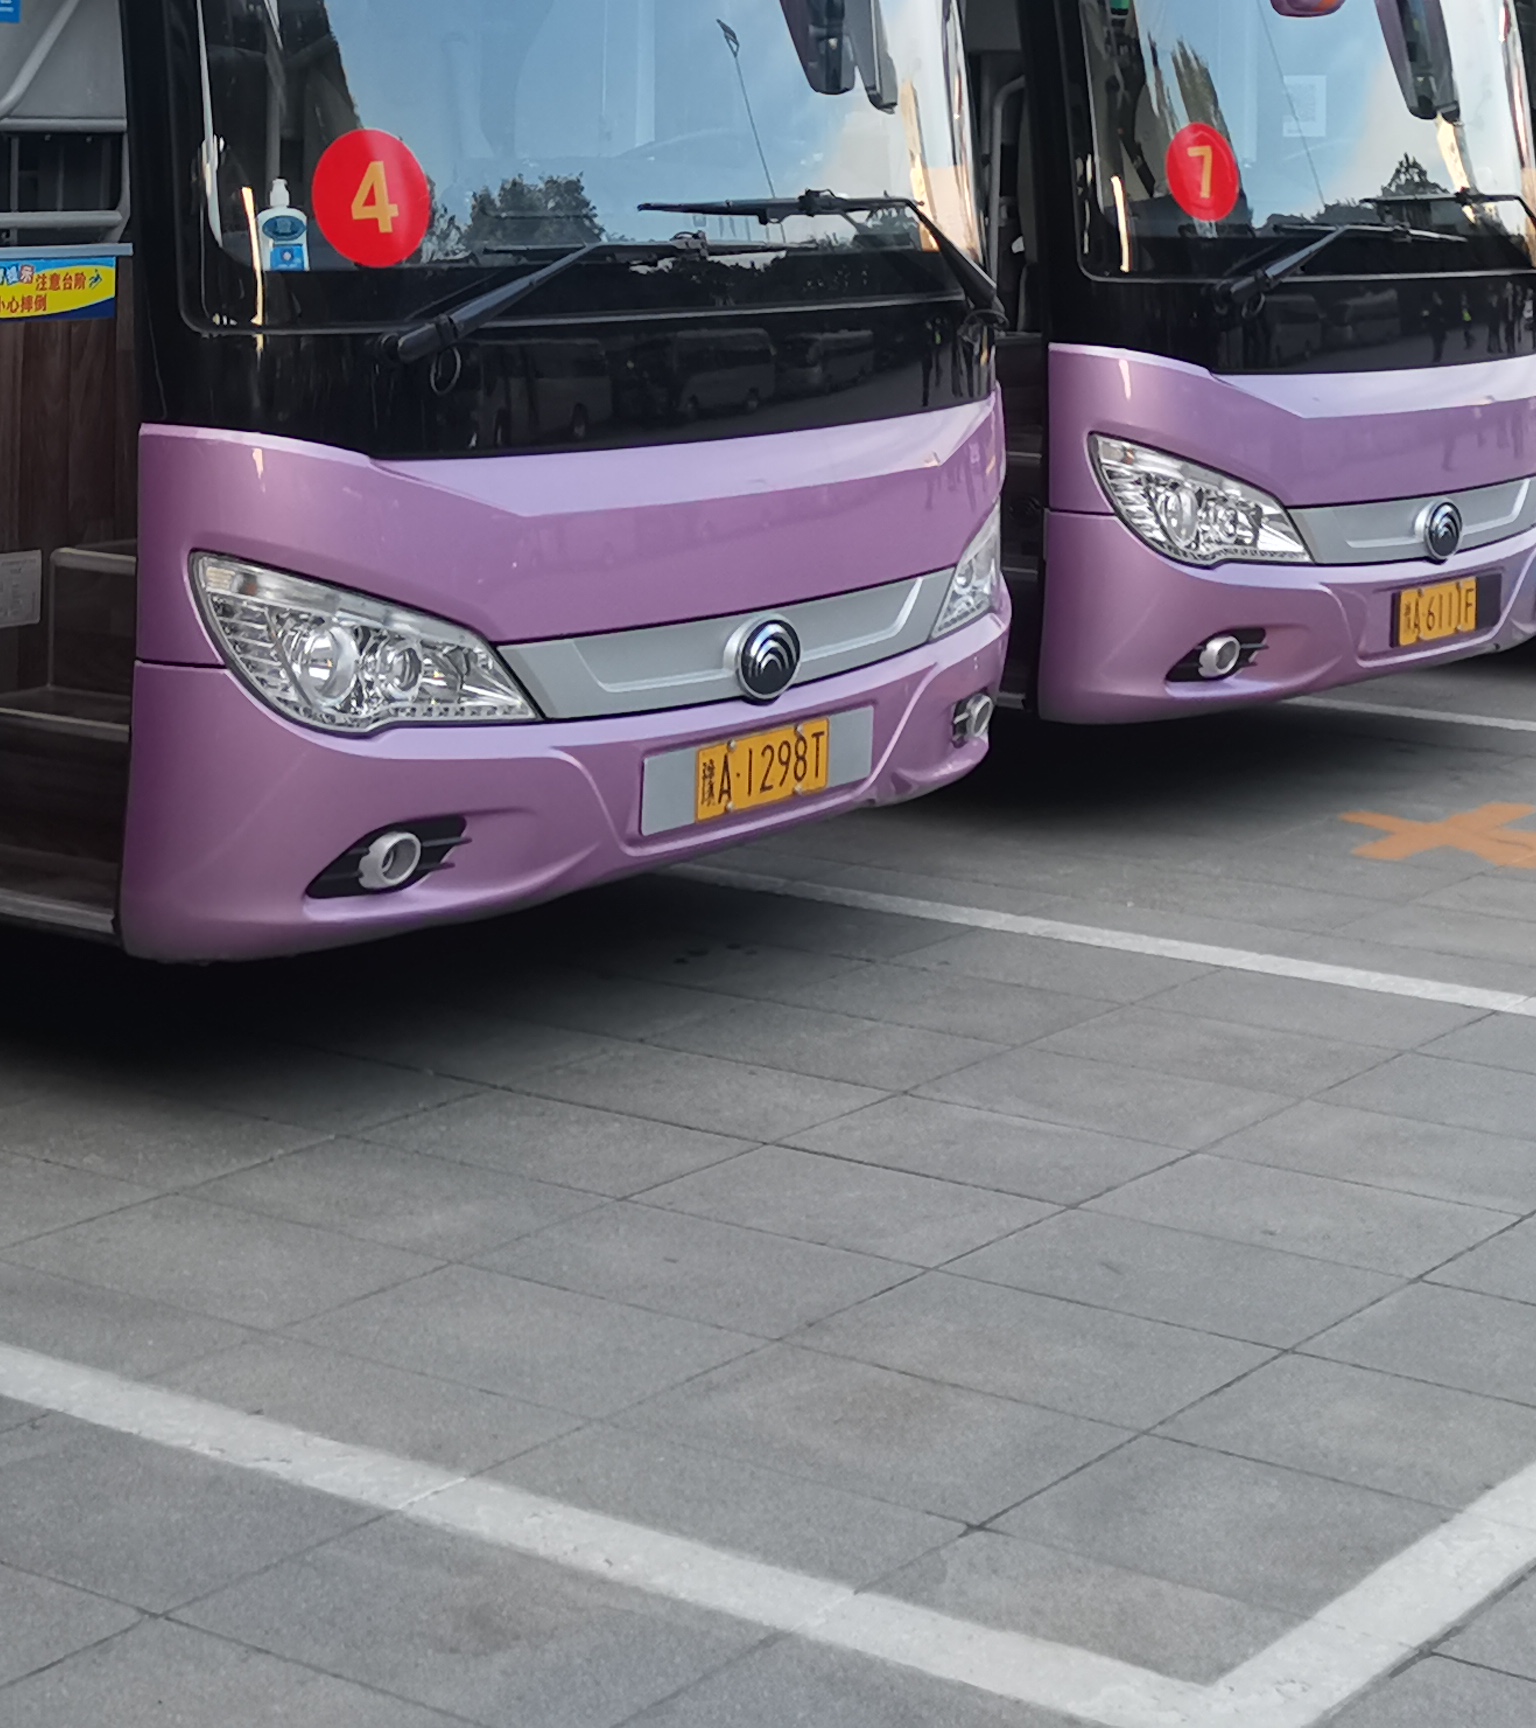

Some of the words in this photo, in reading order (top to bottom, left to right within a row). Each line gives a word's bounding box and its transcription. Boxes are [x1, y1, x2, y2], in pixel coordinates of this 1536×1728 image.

[351, 160, 399, 233] 4
[1187, 145, 1212, 199] 7
[35, 272, 86, 291] 注意台阶
